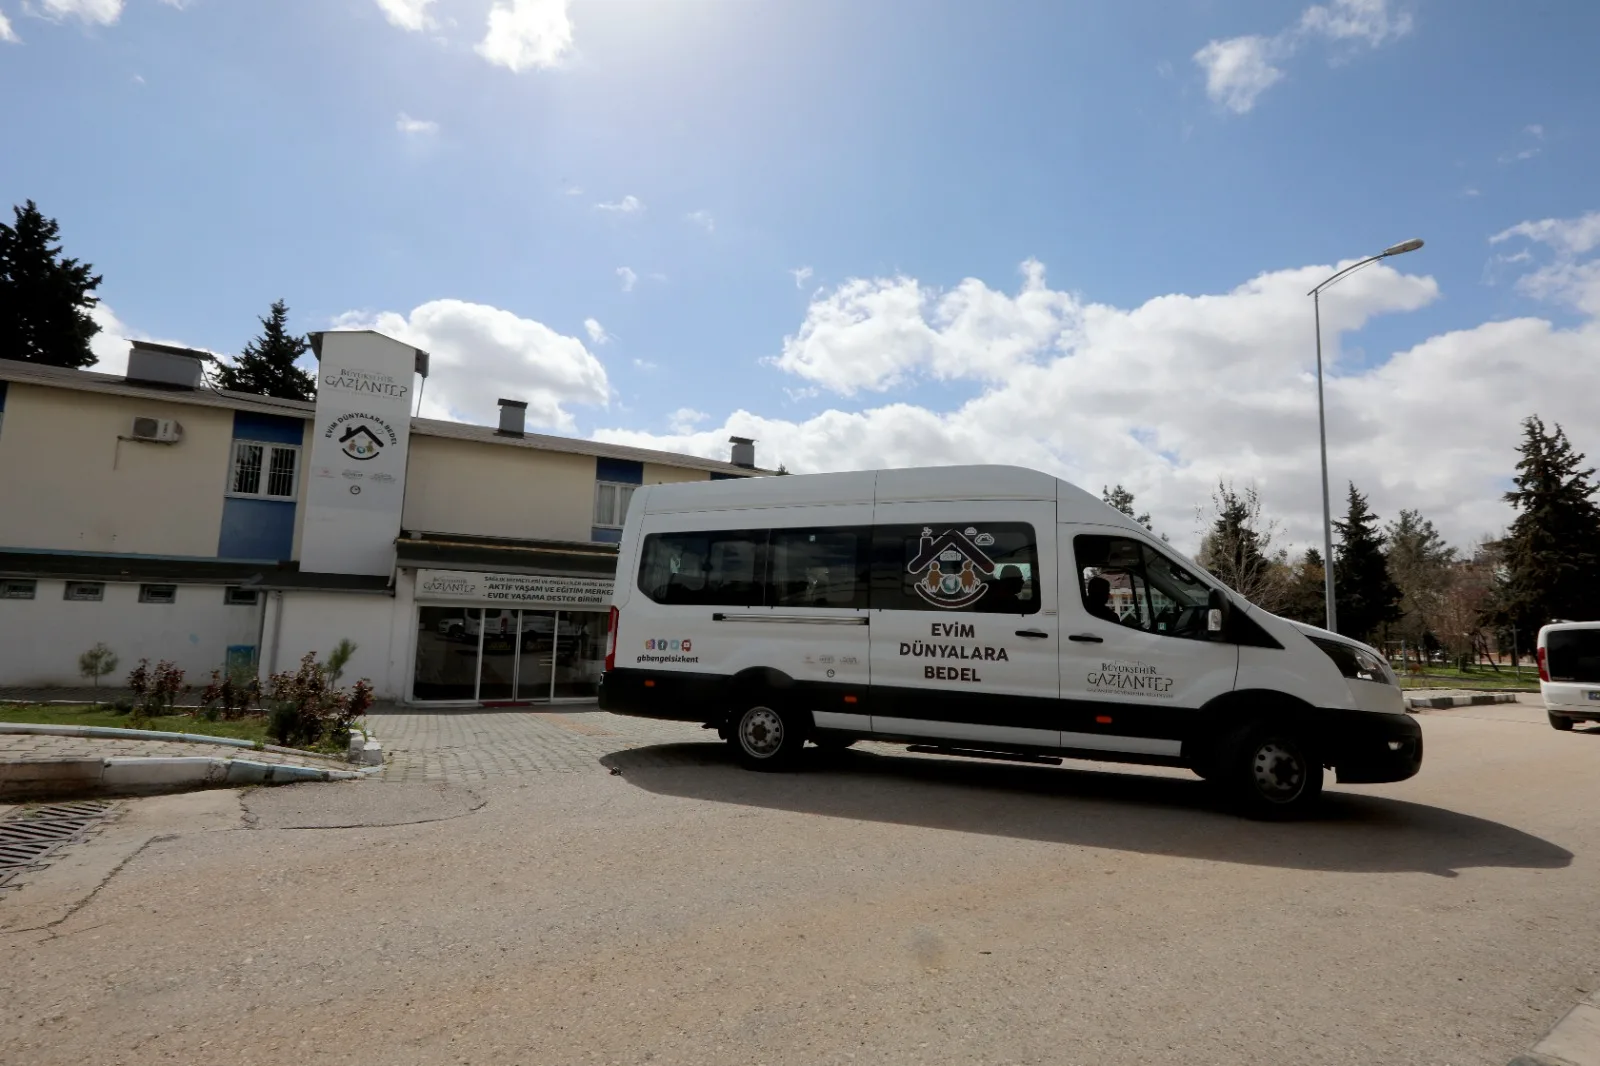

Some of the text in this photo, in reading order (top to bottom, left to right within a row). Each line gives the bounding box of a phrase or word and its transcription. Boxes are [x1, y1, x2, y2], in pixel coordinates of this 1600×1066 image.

[325, 412, 397, 446] EVİM DÜNYALARA BEDEL
[487, 592, 510, 600] EVDE
[511, 593, 545, 601] YAŞAMA
[488, 583, 513, 591] AKTİF
[514, 584, 543, 593] YAŞAM
[931, 621, 975, 638] EVİM
[636, 654, 699, 664] gbbengelsizkent
[899, 640, 1009, 662] DÜNYALARA
[924, 665, 981, 682] BEDEL
[1087, 672, 1174, 692] GAZİANTEP
